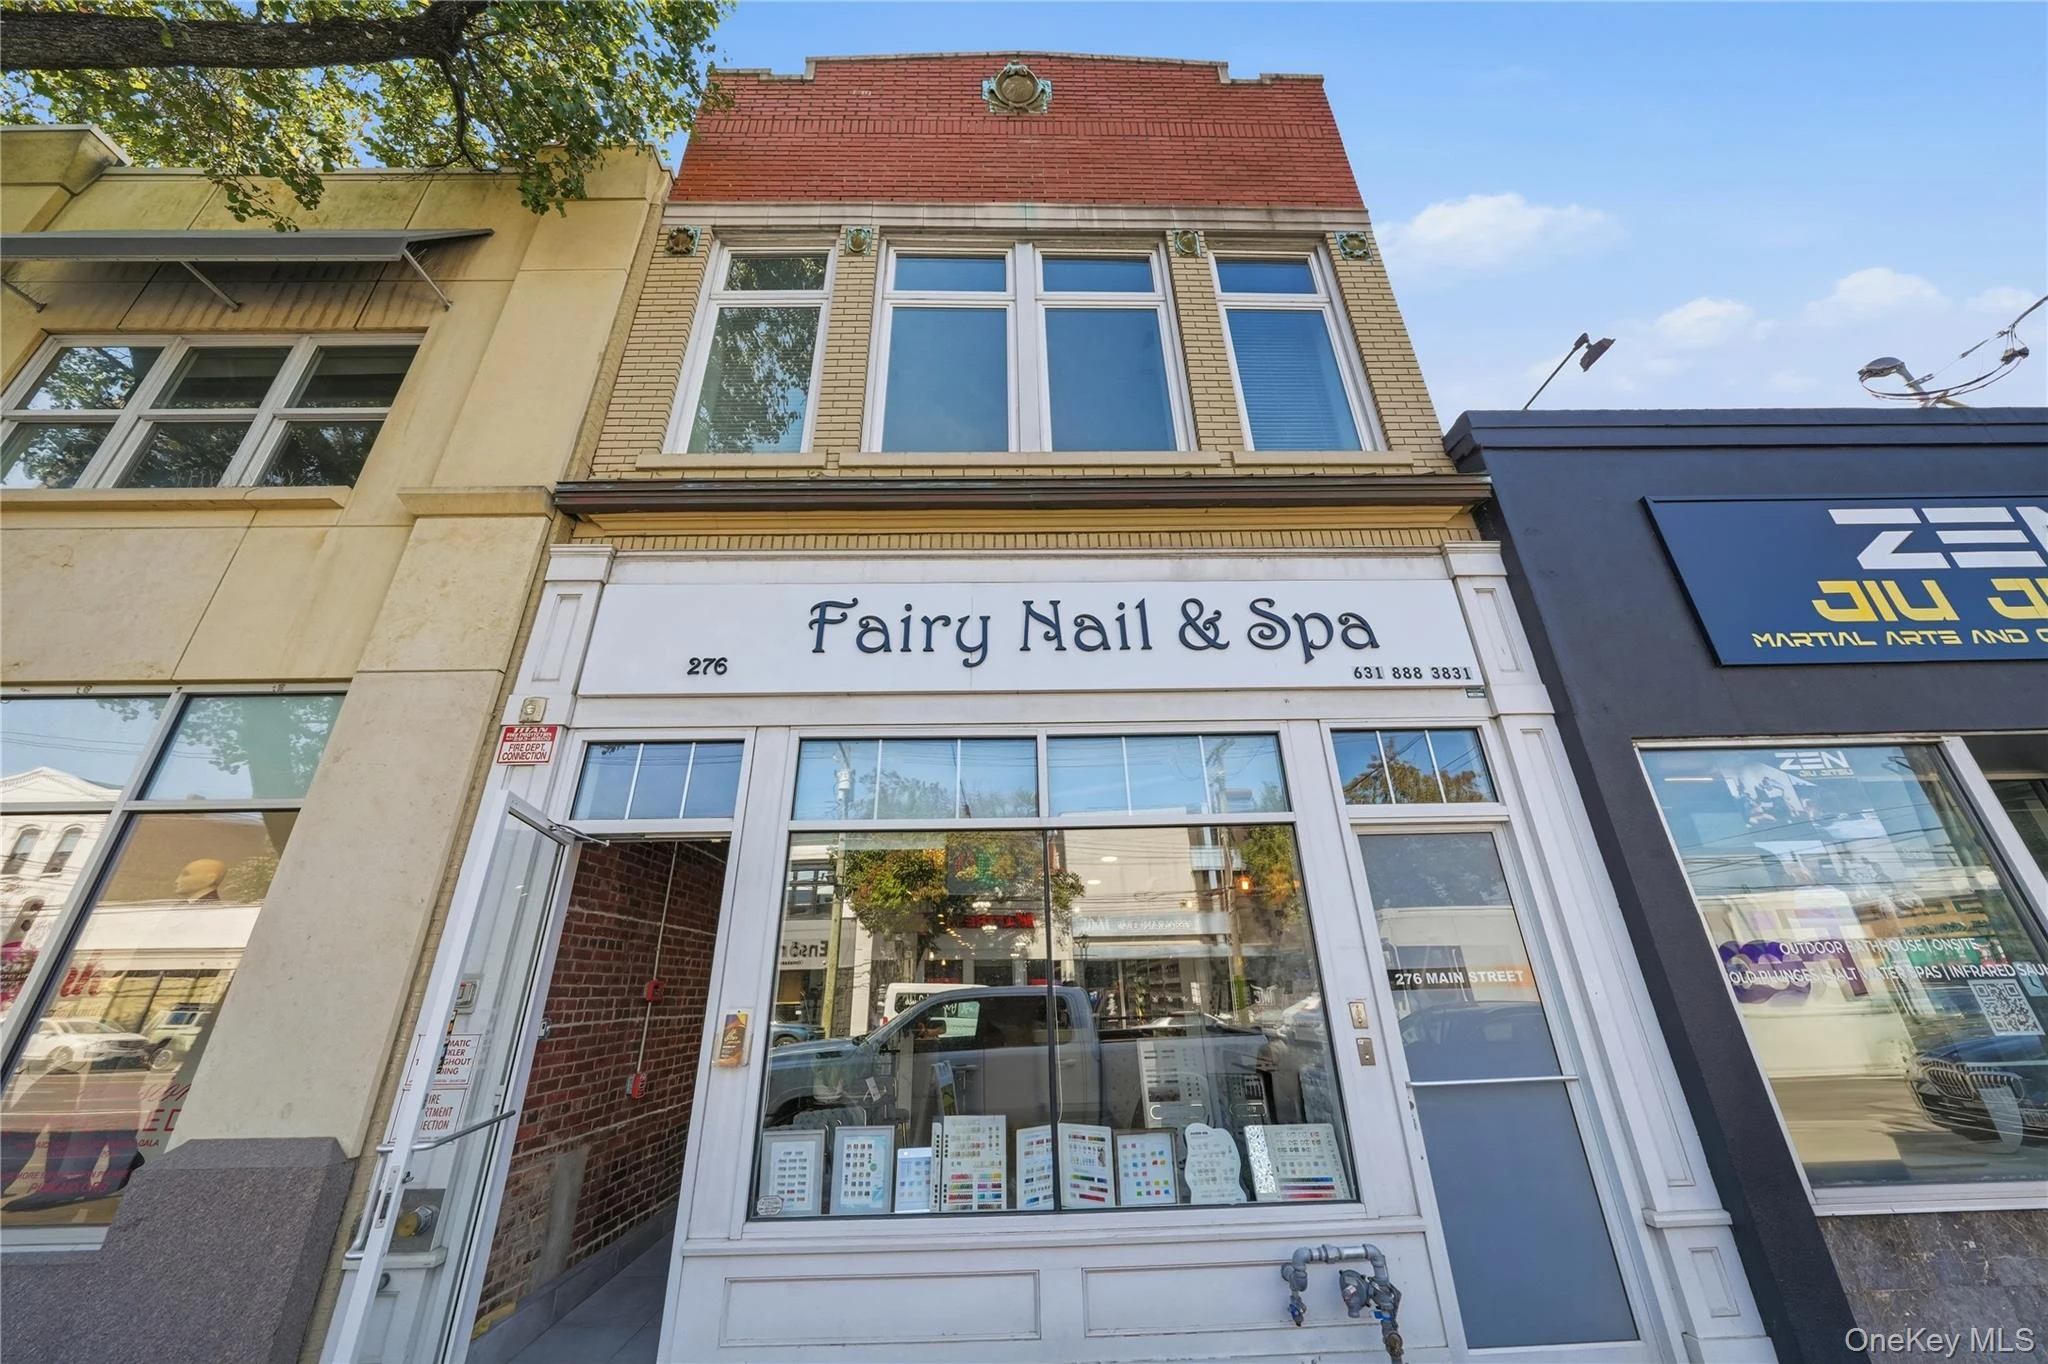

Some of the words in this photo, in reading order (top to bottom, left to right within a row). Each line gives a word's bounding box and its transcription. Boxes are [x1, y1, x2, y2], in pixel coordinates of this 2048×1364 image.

[1812, 580, 1960, 622] JIU
[809, 597, 992, 667] Fairy
[1019, 598, 1154, 653] Nail
[1178, 598, 1230, 650] &
[1246, 597, 1381, 664] Spa
[1752, 631, 1877, 648] MARTIAL
[1887, 629, 1963, 646] ARTS
[1972, 628, 2029, 645] AND
[687, 657, 728, 676] 276
[1353, 667, 1383, 680] 631
[1392, 667, 1423, 680] 888
[1431, 667, 1471, 680] 3831
[502, 752, 547, 761] CONNECTION
[508, 743, 524, 752] FIRE
[525, 743, 546, 751] DEPT.
[1775, 750, 1850, 770] ZEN
[1780, 941, 1845, 955] OUTDOOR
[1932, 937, 1977, 951] ONSITE
[1395, 973, 1423, 986] 276
[1426, 972, 1465, 985] MAIN
[1468, 970, 1524, 983] STREET
[1729, 970, 1755, 985] OLD
[1949, 964, 2016, 978] INFRARED
